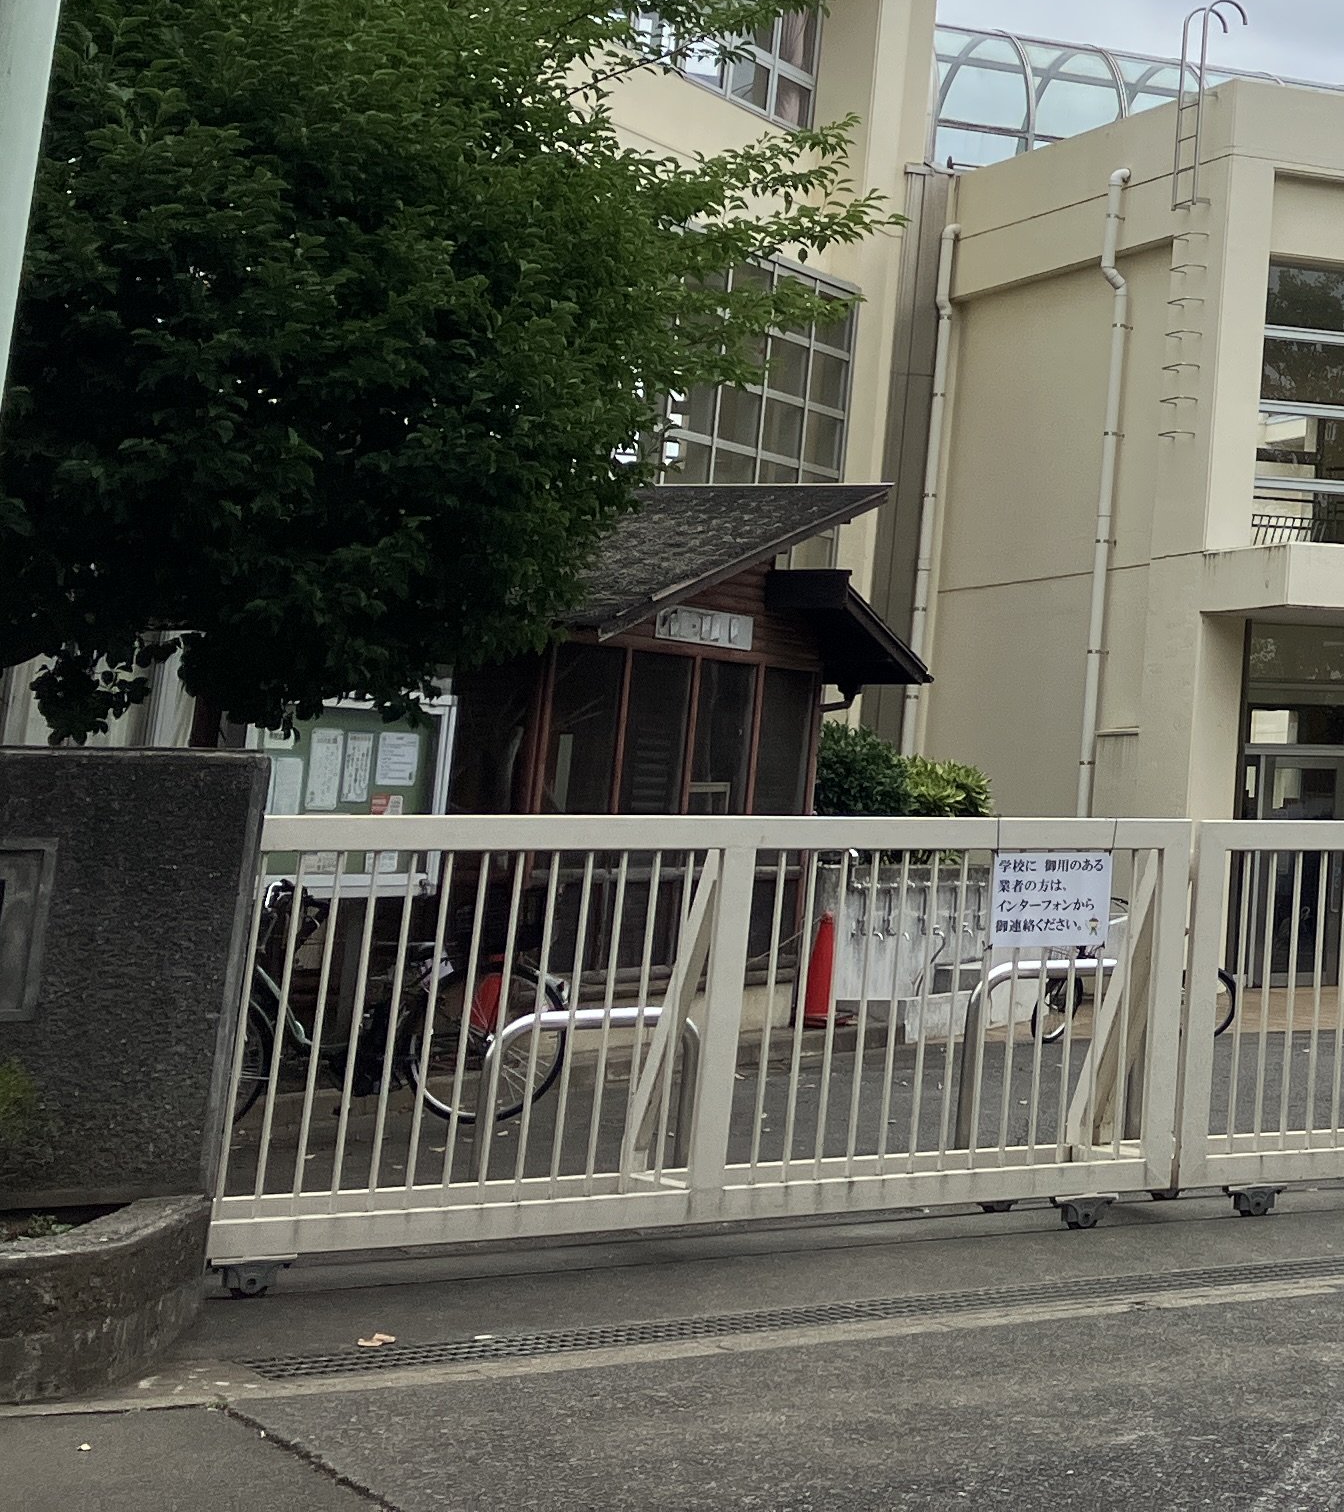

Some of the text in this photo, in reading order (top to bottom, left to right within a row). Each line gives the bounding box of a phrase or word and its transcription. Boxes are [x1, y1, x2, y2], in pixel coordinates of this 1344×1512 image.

[998, 858, 1104, 873] 学校に 御用のある
[998, 879, 1067, 893] 業者の方は、
[996, 898, 1095, 913] インターフォンから
[995, 918, 1082, 933] 御連絡ください。
